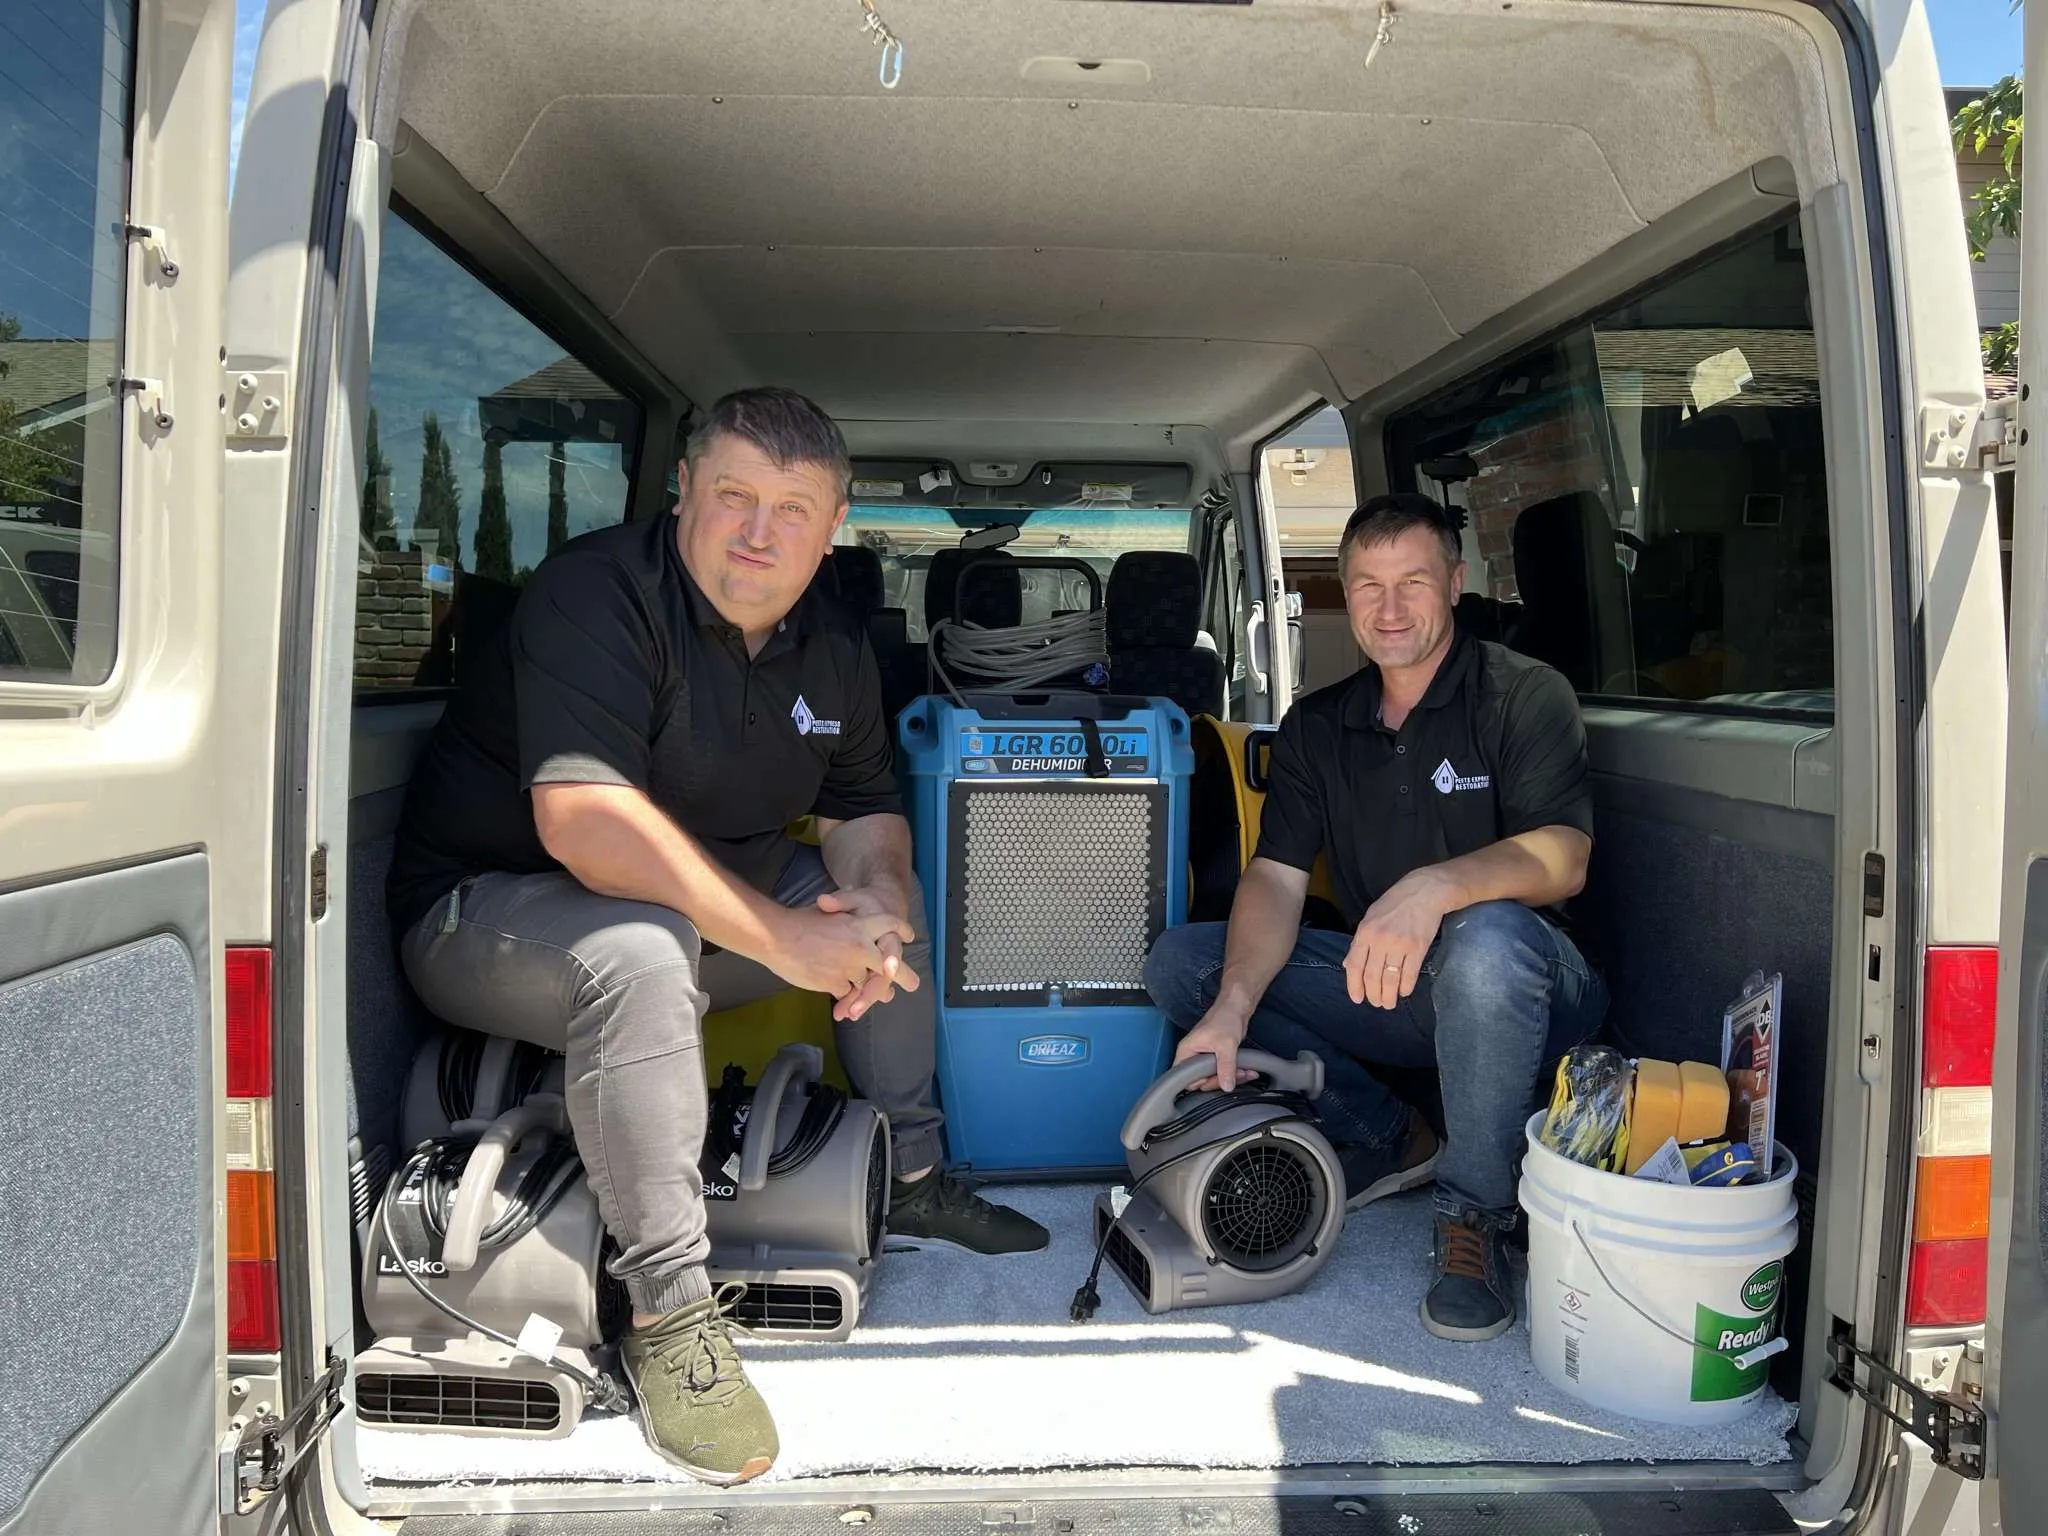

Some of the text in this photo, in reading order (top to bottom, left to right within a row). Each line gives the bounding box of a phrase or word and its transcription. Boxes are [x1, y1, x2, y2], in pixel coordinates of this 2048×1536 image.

[992, 735, 1137, 755] LGR 600Li
[1011, 758, 1113, 770] DEHUMIDIR
[701, 1181, 734, 1197] sko
[380, 1255, 446, 1274] Lasko
[1717, 1320, 1770, 1350] Ready
